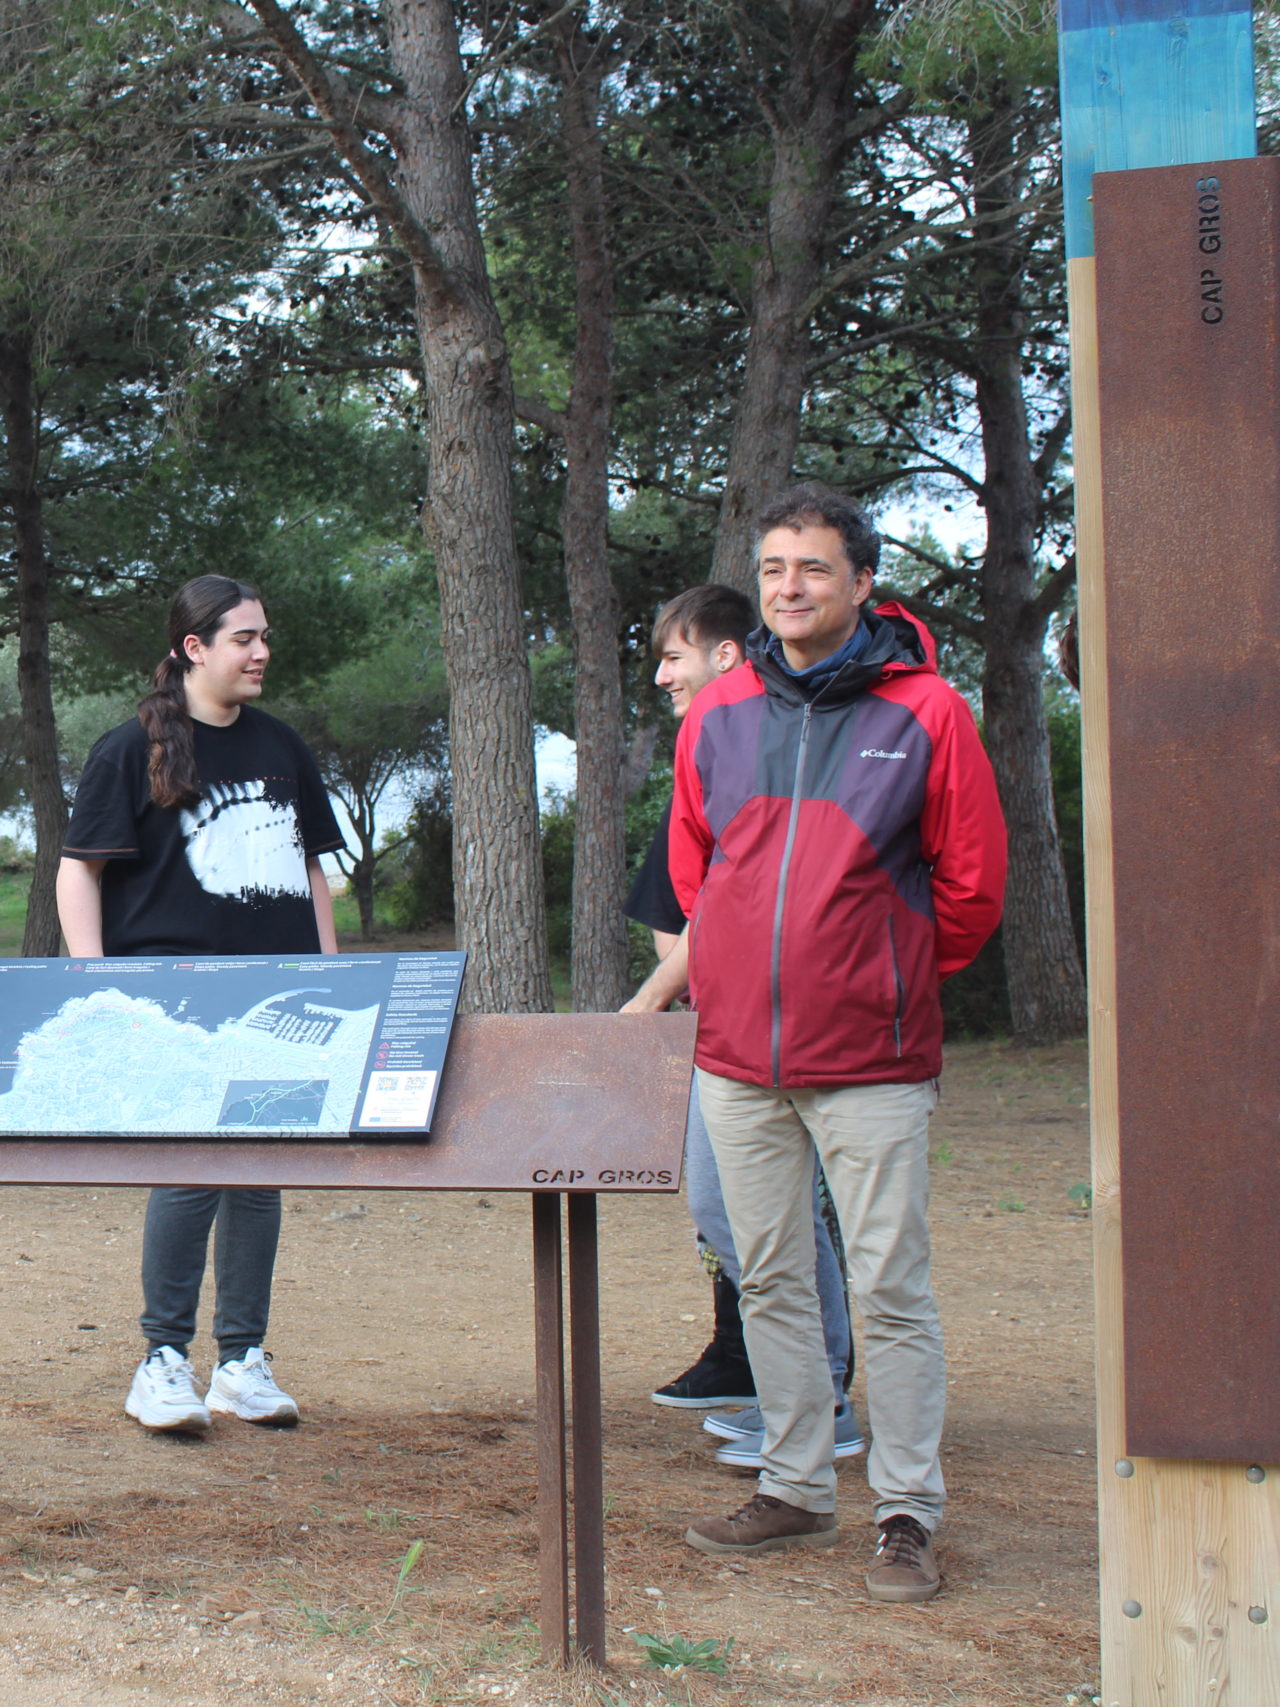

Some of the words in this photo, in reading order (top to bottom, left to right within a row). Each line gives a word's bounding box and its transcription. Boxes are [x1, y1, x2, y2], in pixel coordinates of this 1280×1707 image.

[1196, 175, 1221, 254] GROS
[1201, 269, 1223, 324] CAP
[868, 749, 907, 759] Columbia
[532, 1169, 585, 1183] CAP
[598, 1169, 673, 1184] GROS
